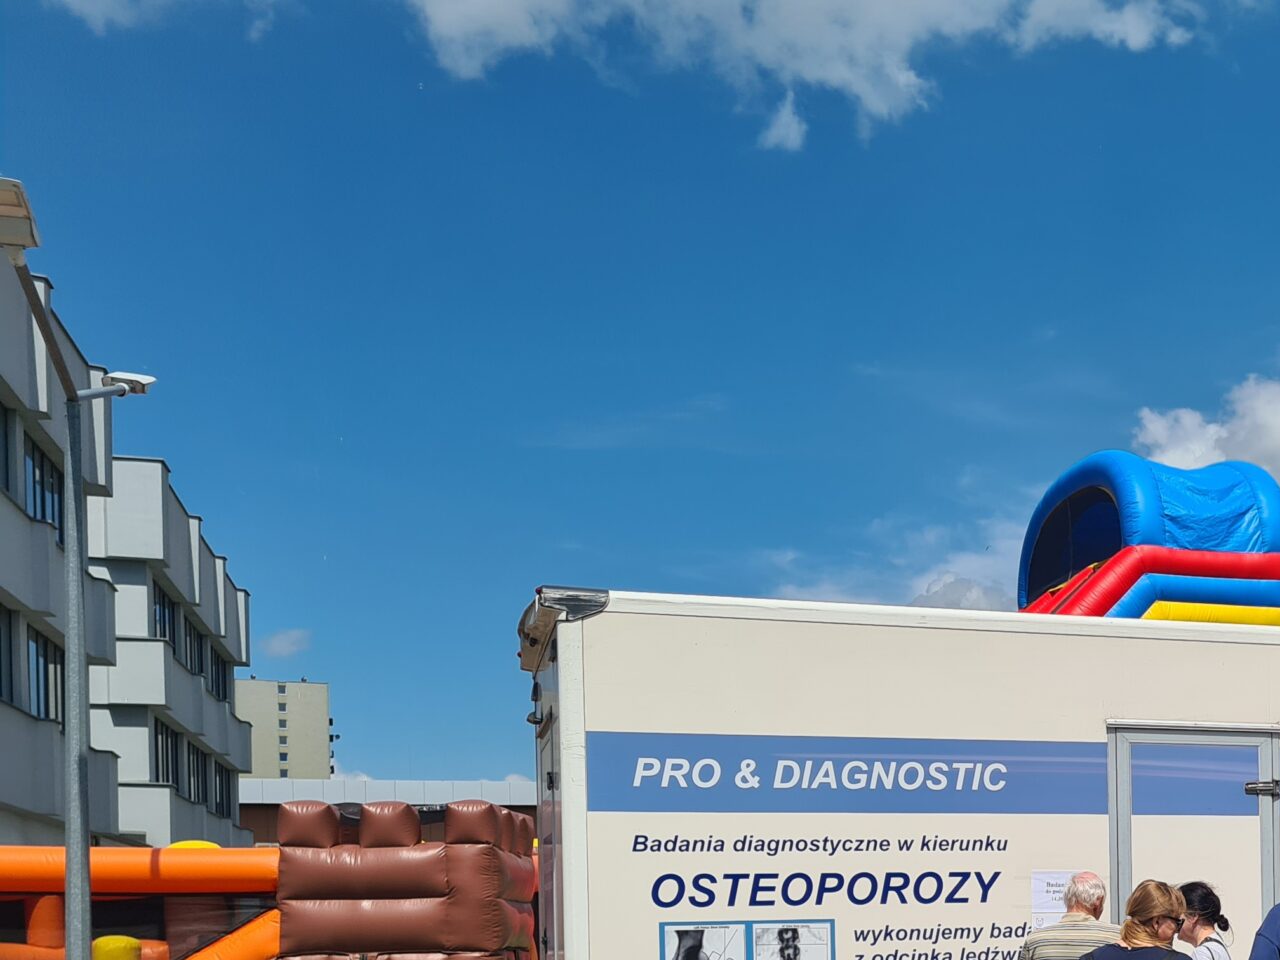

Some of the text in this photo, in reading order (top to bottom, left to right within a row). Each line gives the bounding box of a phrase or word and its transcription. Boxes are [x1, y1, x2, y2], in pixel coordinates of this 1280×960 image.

[633, 757, 1008, 791] PRO & DIAGNOSTIC
[631, 834, 1008, 857] Badania diagnostyczne w kierunku
[650, 871, 1002, 908] OSTEOPOROZY
[853, 923, 984, 946] wykonujemy
